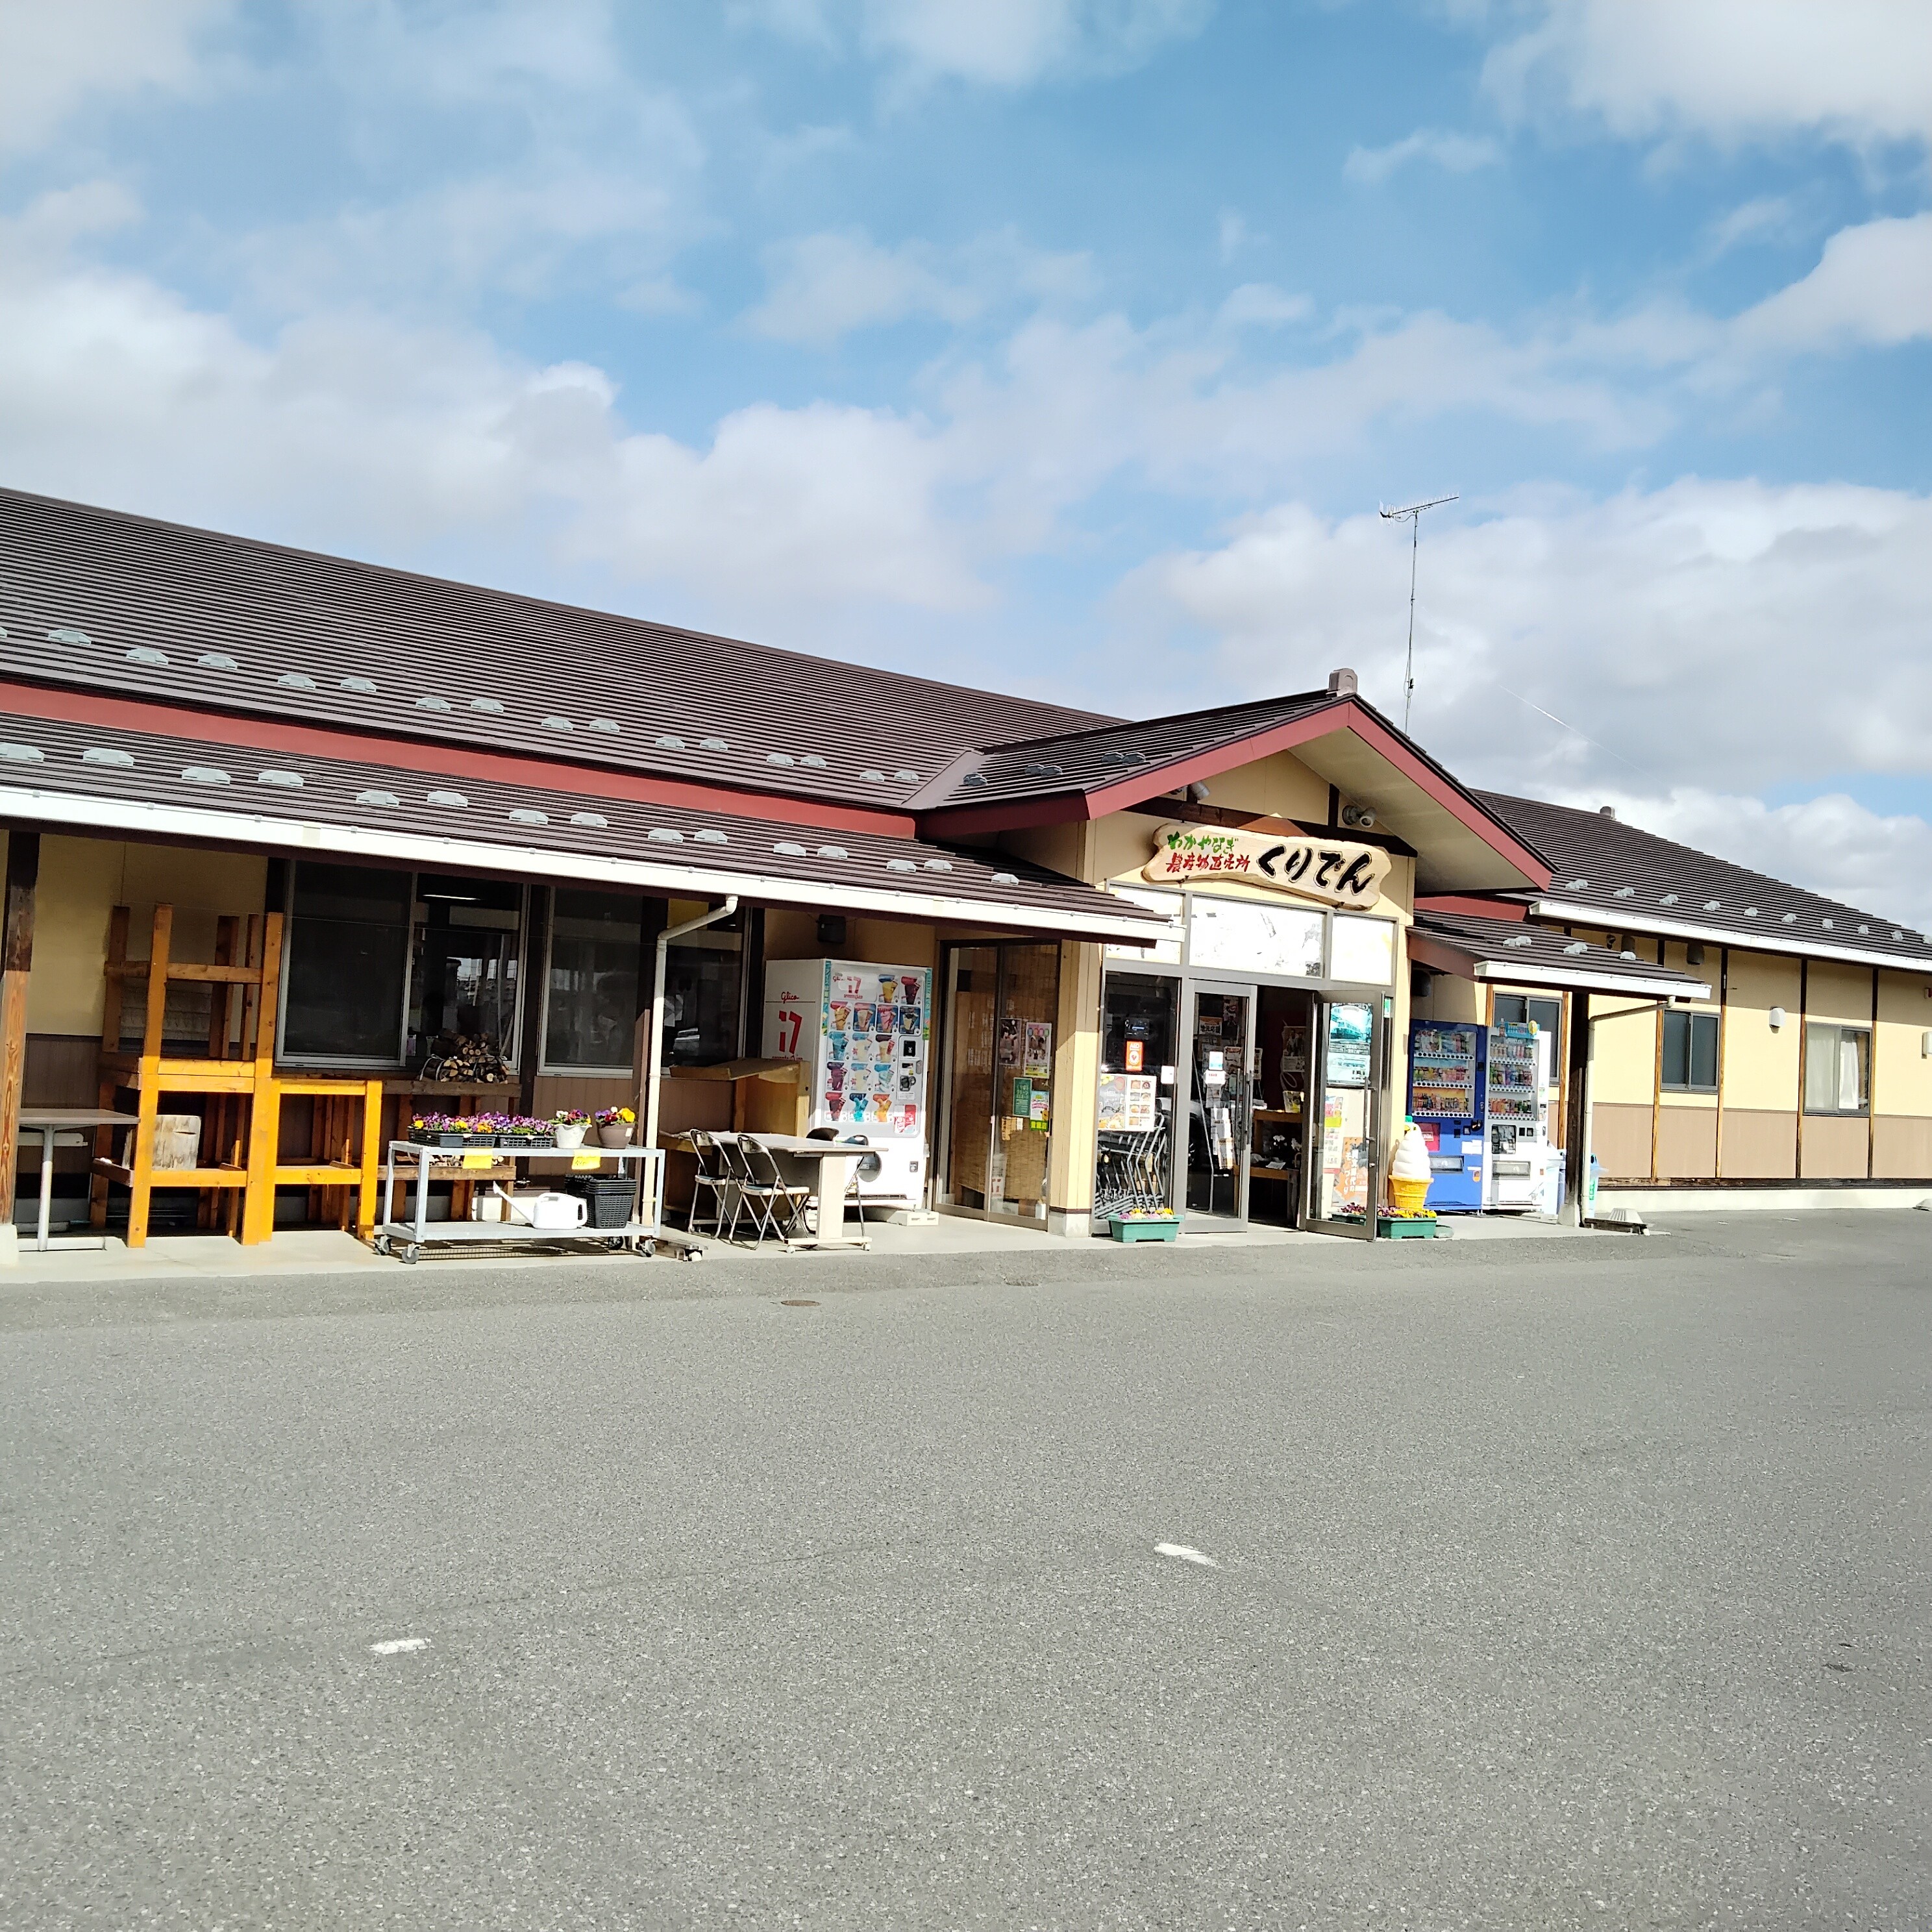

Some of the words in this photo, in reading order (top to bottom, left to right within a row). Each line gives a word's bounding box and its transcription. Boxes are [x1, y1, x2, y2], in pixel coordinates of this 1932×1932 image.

[1167, 831, 1239, 854] わかやなぎ
[1166, 852, 1250, 873] 農産物直売所
[1256, 844, 1375, 896] くりでん
[781, 991, 799, 1004] Glico
[779, 1010, 802, 1054] 17
